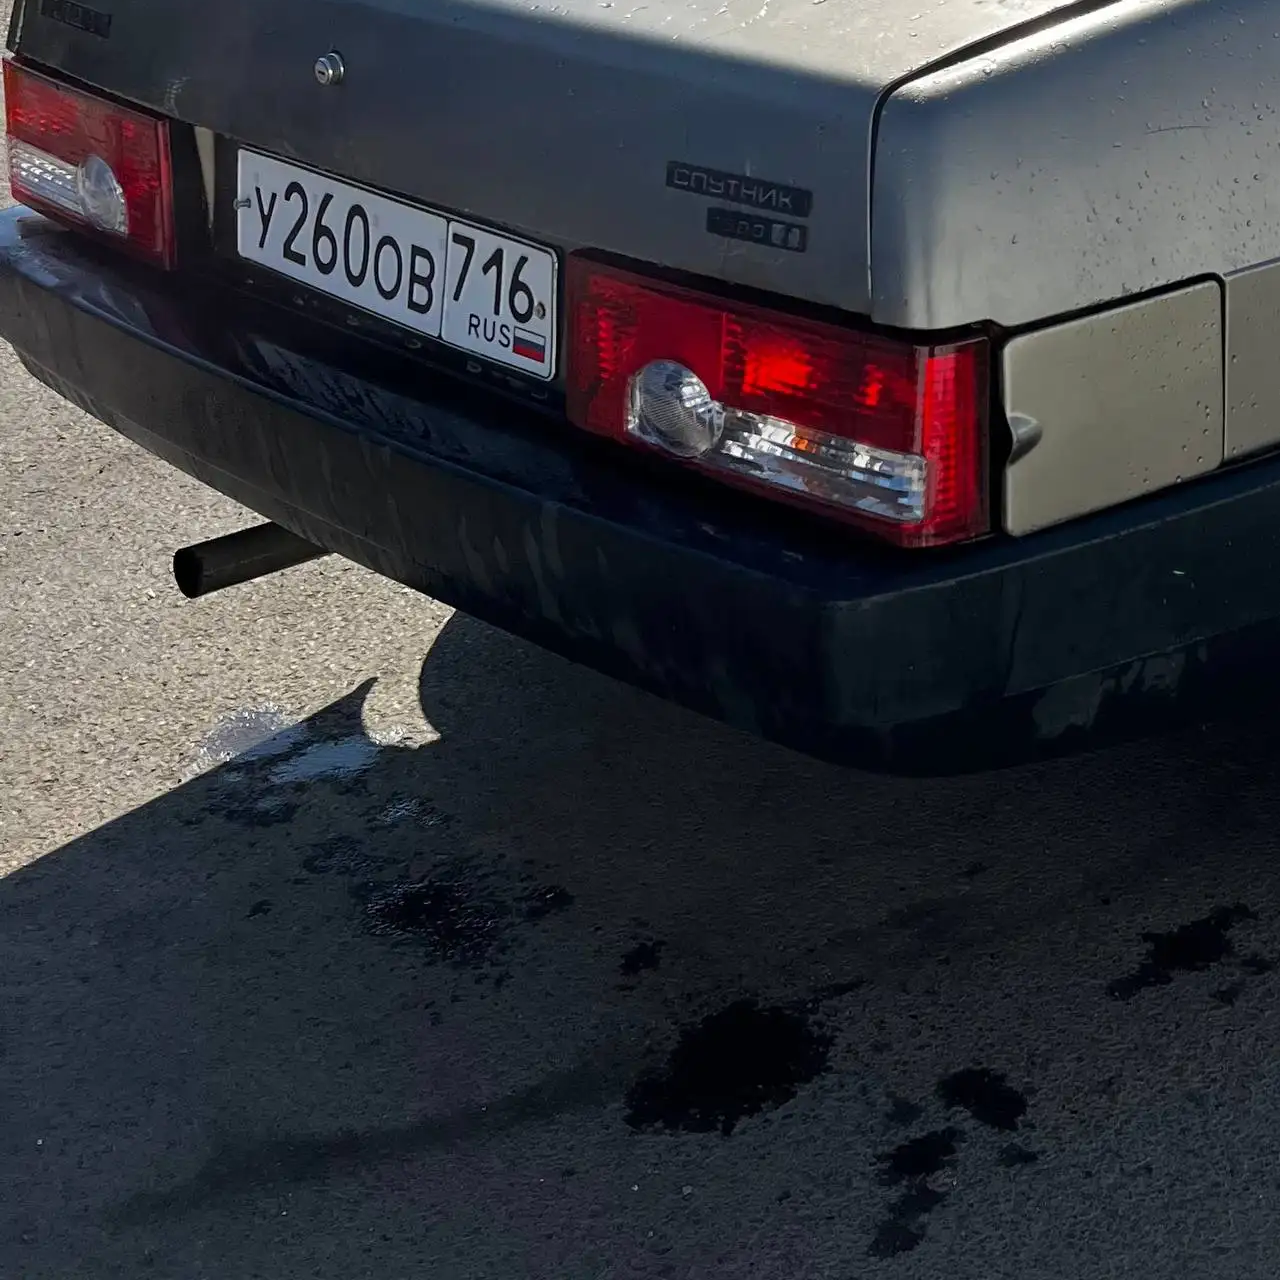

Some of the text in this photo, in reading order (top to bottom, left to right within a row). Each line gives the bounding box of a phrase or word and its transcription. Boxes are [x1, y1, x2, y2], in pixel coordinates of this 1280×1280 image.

[673, 168, 794, 209] СПУТНИК
[255, 181, 535, 324] У260ОВ 716
[468, 313, 511, 349] RUS
